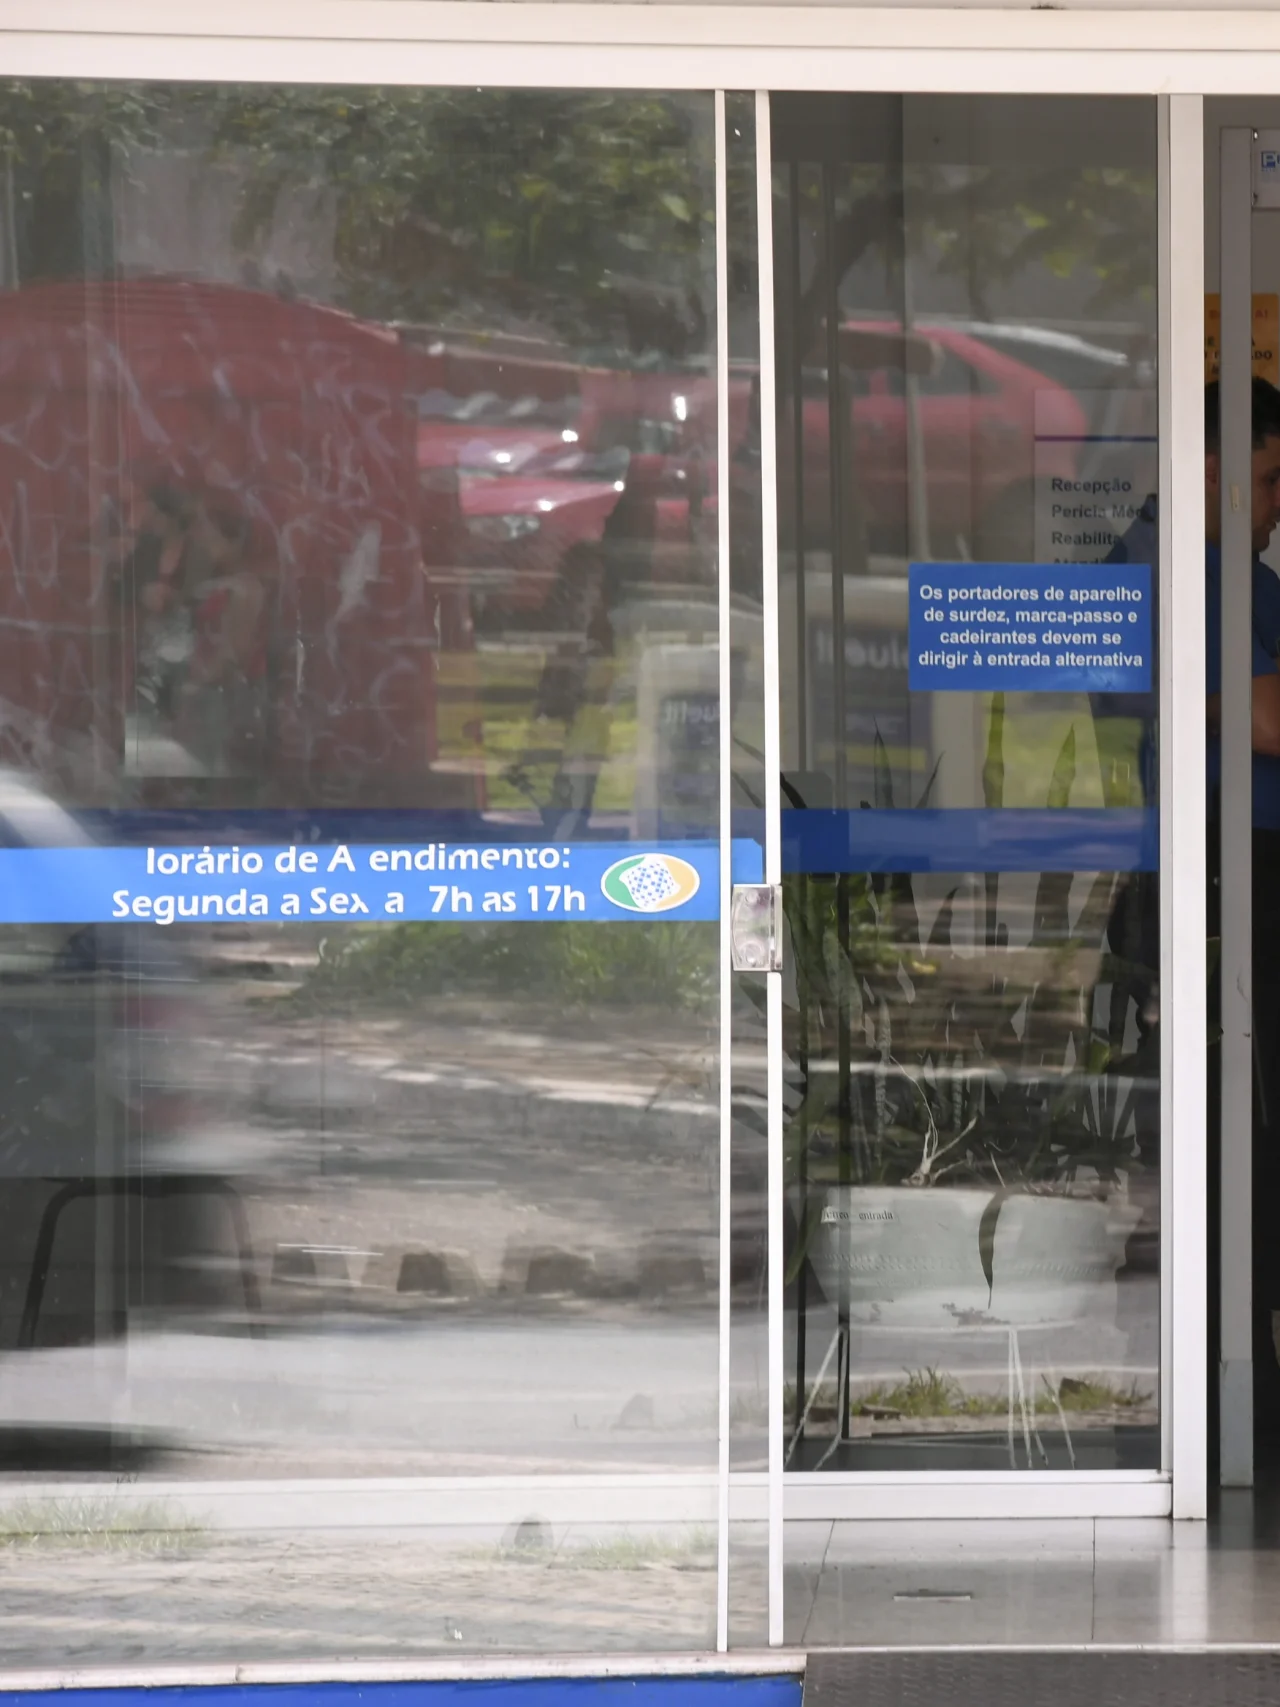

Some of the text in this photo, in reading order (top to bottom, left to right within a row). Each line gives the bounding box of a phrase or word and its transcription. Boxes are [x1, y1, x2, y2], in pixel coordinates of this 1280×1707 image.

[1052, 478, 1132, 494] Recepção
[919, 585, 1142, 604] Os portadores de aparelho
[924, 608, 1138, 626] de surdez, marca-passo e
[940, 629, 1122, 645] cadeirantes devem se
[918, 651, 1143, 670] dirigir à entrada alternativa
[274, 845, 319, 873] de
[112, 888, 269, 925] Segunda
[280, 893, 299, 915] a
[429, 885, 473, 913] 7h
[482, 891, 516, 913] as
[528, 884, 586, 912] 17h
[858, 1209, 894, 1220] entrada
